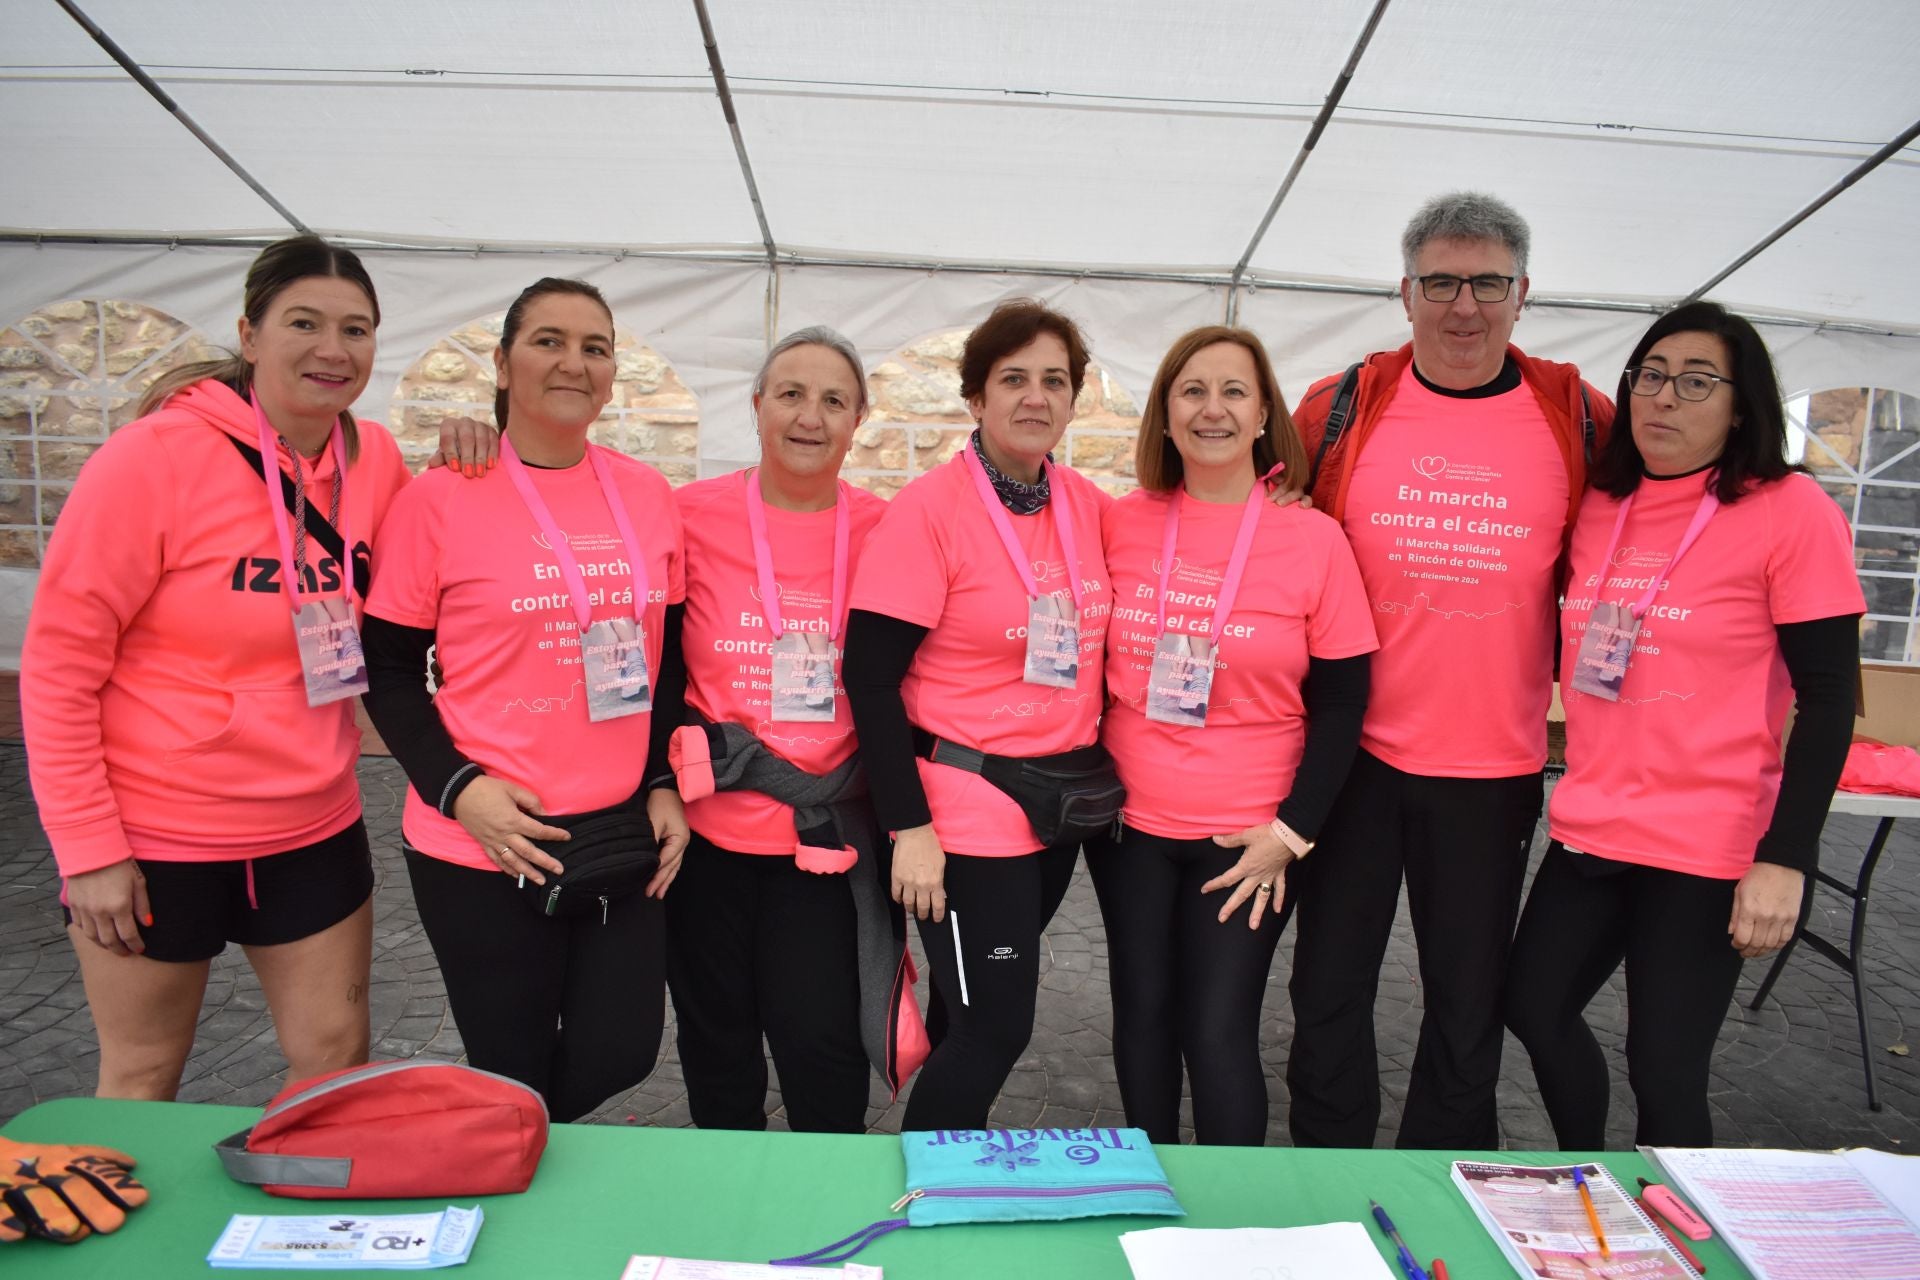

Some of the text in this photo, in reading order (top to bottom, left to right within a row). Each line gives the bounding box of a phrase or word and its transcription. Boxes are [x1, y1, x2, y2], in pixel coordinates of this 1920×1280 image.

[1445, 468, 1502, 478] Asociación Española
[1397, 484, 1508, 510] En marcha
[1370, 511, 1532, 540] contra el cáncer
[570, 538, 599, 546] Asociación
[1395, 537, 1502, 557] II Marcha solidaria
[1388, 552, 1508, 572] en Rincón de Olivedo
[533, 562, 561, 580] En
[1178, 569, 1205, 579] Asociación
[1420, 572, 1460, 583] diciembre
[1461, 576, 1480, 585] 2024
[1136, 583, 1155, 599] En
[511, 587, 666, 613] contr el cácer
[782, 594, 809, 602] Asociación
[740, 612, 763, 628] En
[1032, 613, 1057, 625] Estoy
[1166, 614, 1184, 630] el
[301, 616, 354, 637] Estoy aquí
[544, 622, 553, 632] II
[1590, 621, 1616, 635] Estoy
[1043, 632, 1064, 642] para
[318, 640, 343, 656] para
[538, 640, 554, 650] en
[586, 638, 641, 656] Estoy aquí
[1118, 645, 1128, 654] en
[1595, 642, 1617, 654] para
[776, 651, 807, 662] Estoy
[806, 652, 831, 662] aquí
[1033, 648, 1073, 660] ayudarte
[1158, 652, 1187, 664] Estoy
[1186, 656, 1211, 668] aquí
[311, 656, 358, 676] ayudarte
[604, 659, 628, 672] para
[1136, 664, 1145, 672] de
[1582, 656, 1621, 673] ayudarte
[790, 670, 816, 679] para
[1168, 670, 1193, 682] para
[594, 676, 641, 692] ayudarte
[732, 681, 746, 689] en
[780, 686, 827, 696] ayudarte
[1156, 686, 1202, 700] ayudarte
